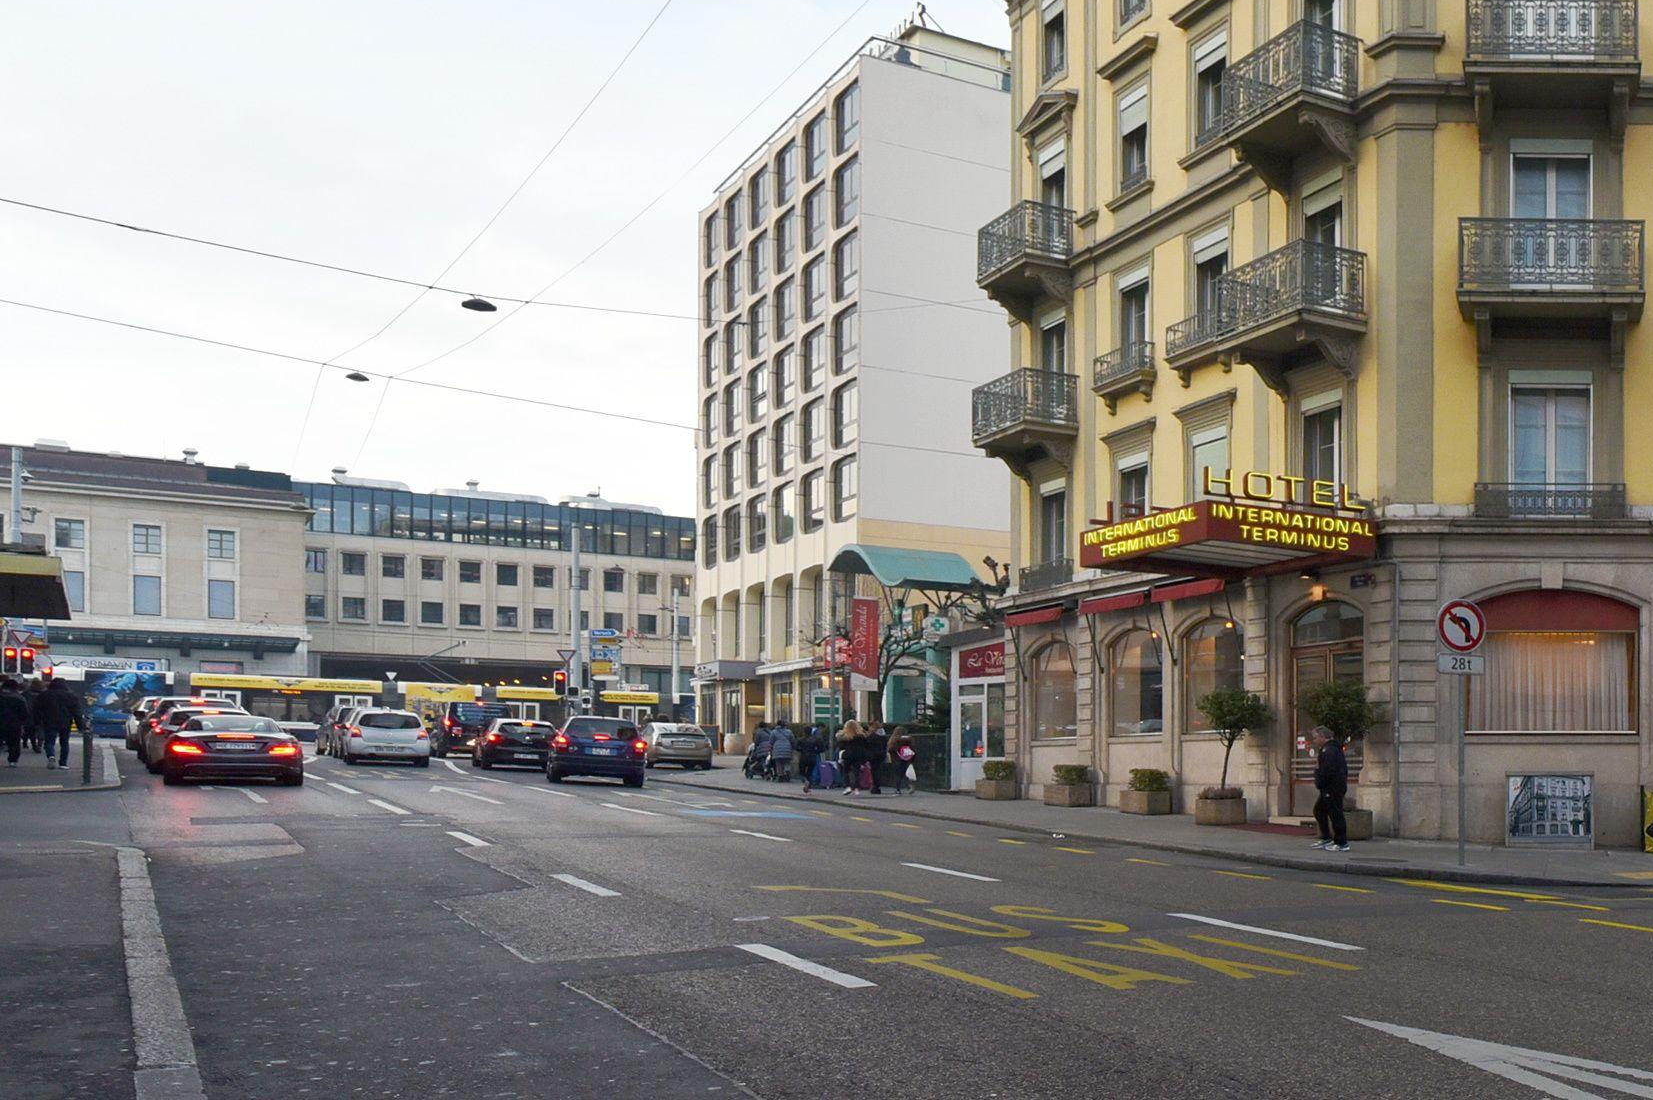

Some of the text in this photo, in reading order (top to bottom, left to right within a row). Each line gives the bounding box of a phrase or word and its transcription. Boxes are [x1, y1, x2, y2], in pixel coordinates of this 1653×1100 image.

[1203, 466, 1366, 511] HOTEL
[1083, 507, 1198, 546] INTERNATIONAL
[1212, 503, 1373, 536] INTERNATIONAL
[1100, 528, 1179, 558] TERMINUS
[1240, 525, 1350, 551] TERMINUS
[72, 659, 132, 669] CORNAVIN
[1451, 657, 1472, 670] 28t
[780, 904, 1130, 948] BUS
[863, 934, 1363, 1000] TAXI
